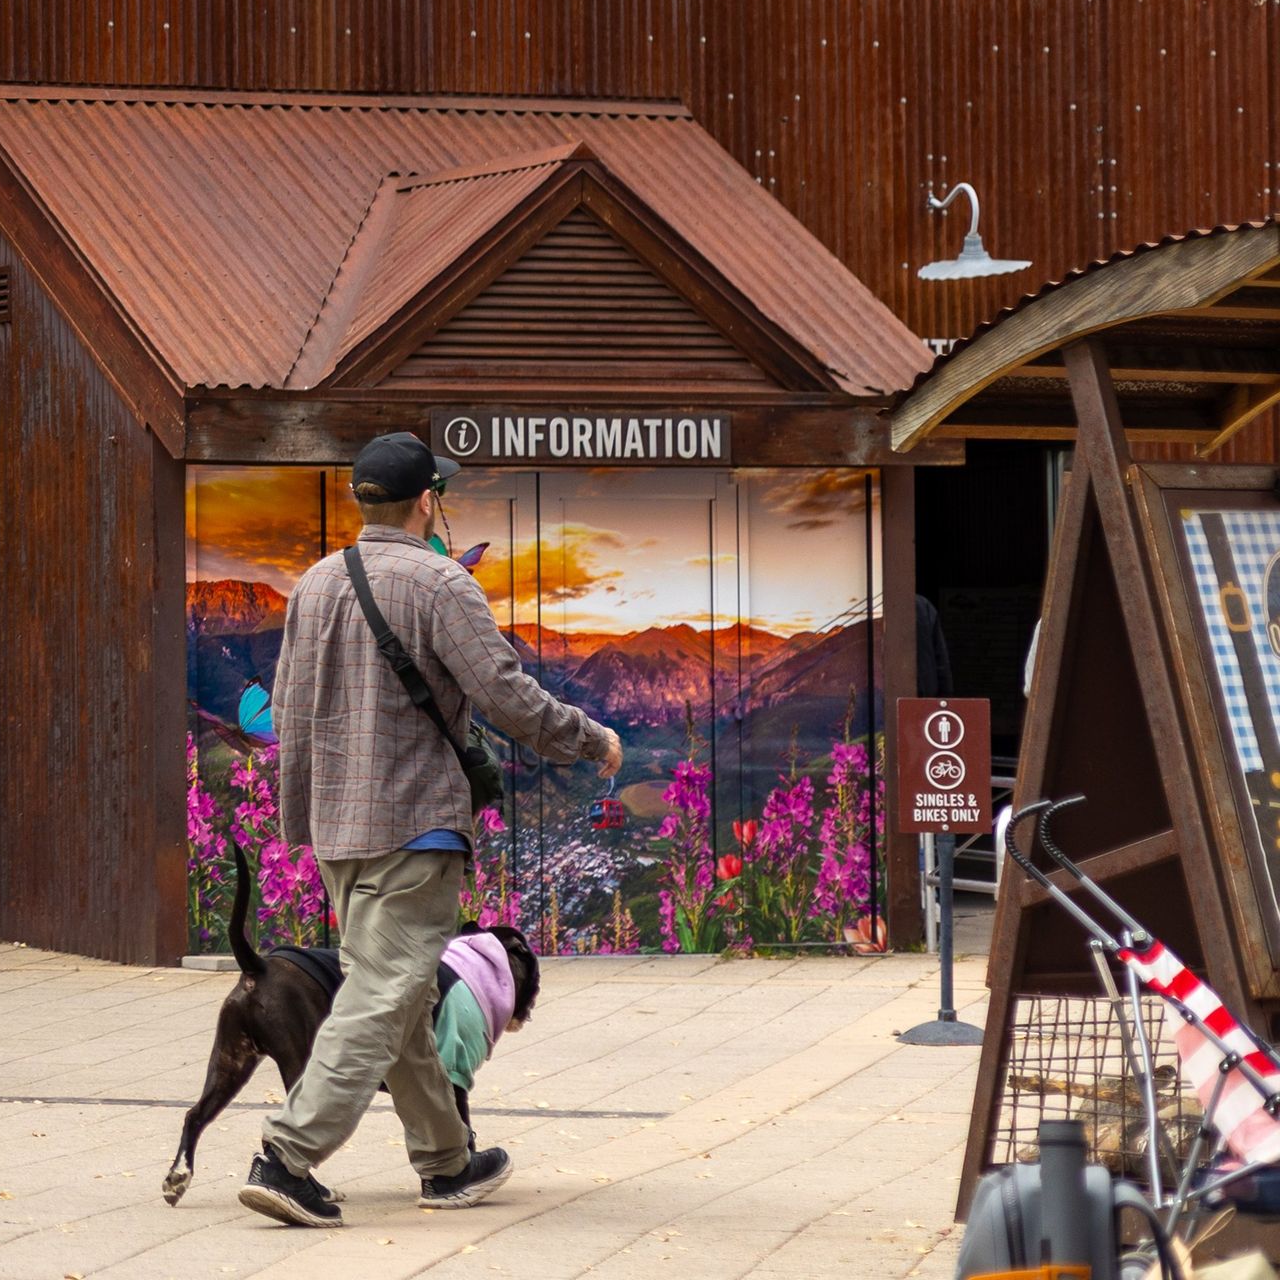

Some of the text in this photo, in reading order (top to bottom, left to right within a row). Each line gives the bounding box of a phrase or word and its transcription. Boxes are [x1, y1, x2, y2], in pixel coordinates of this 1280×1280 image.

[491, 416, 722, 459] INFORMATION
[916, 793, 977, 807] SINGLES &
[914, 808, 981, 822] BIKES ONLY
